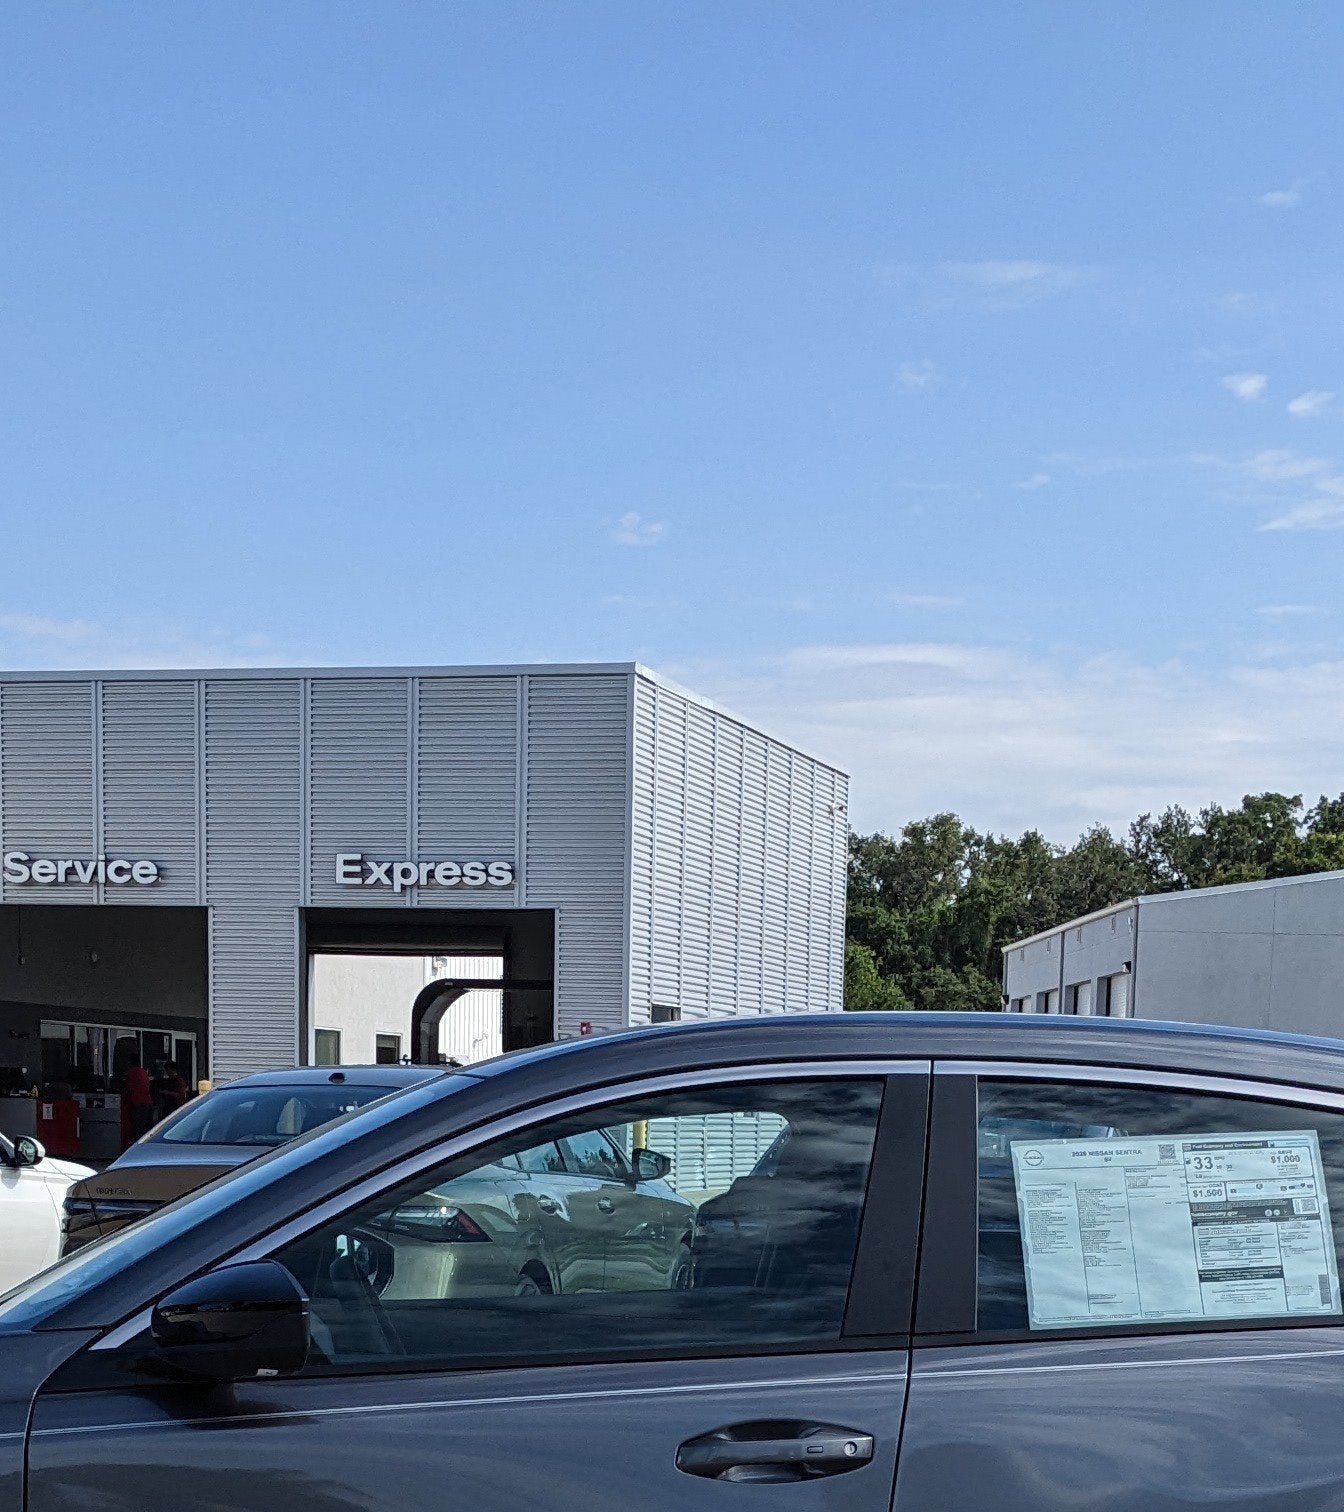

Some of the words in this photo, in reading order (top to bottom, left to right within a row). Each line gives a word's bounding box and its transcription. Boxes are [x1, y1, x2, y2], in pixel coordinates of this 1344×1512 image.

[3, 851, 159, 884] Service
[335, 853, 513, 893] Express
[1193, 1156, 1214, 1170] 33
